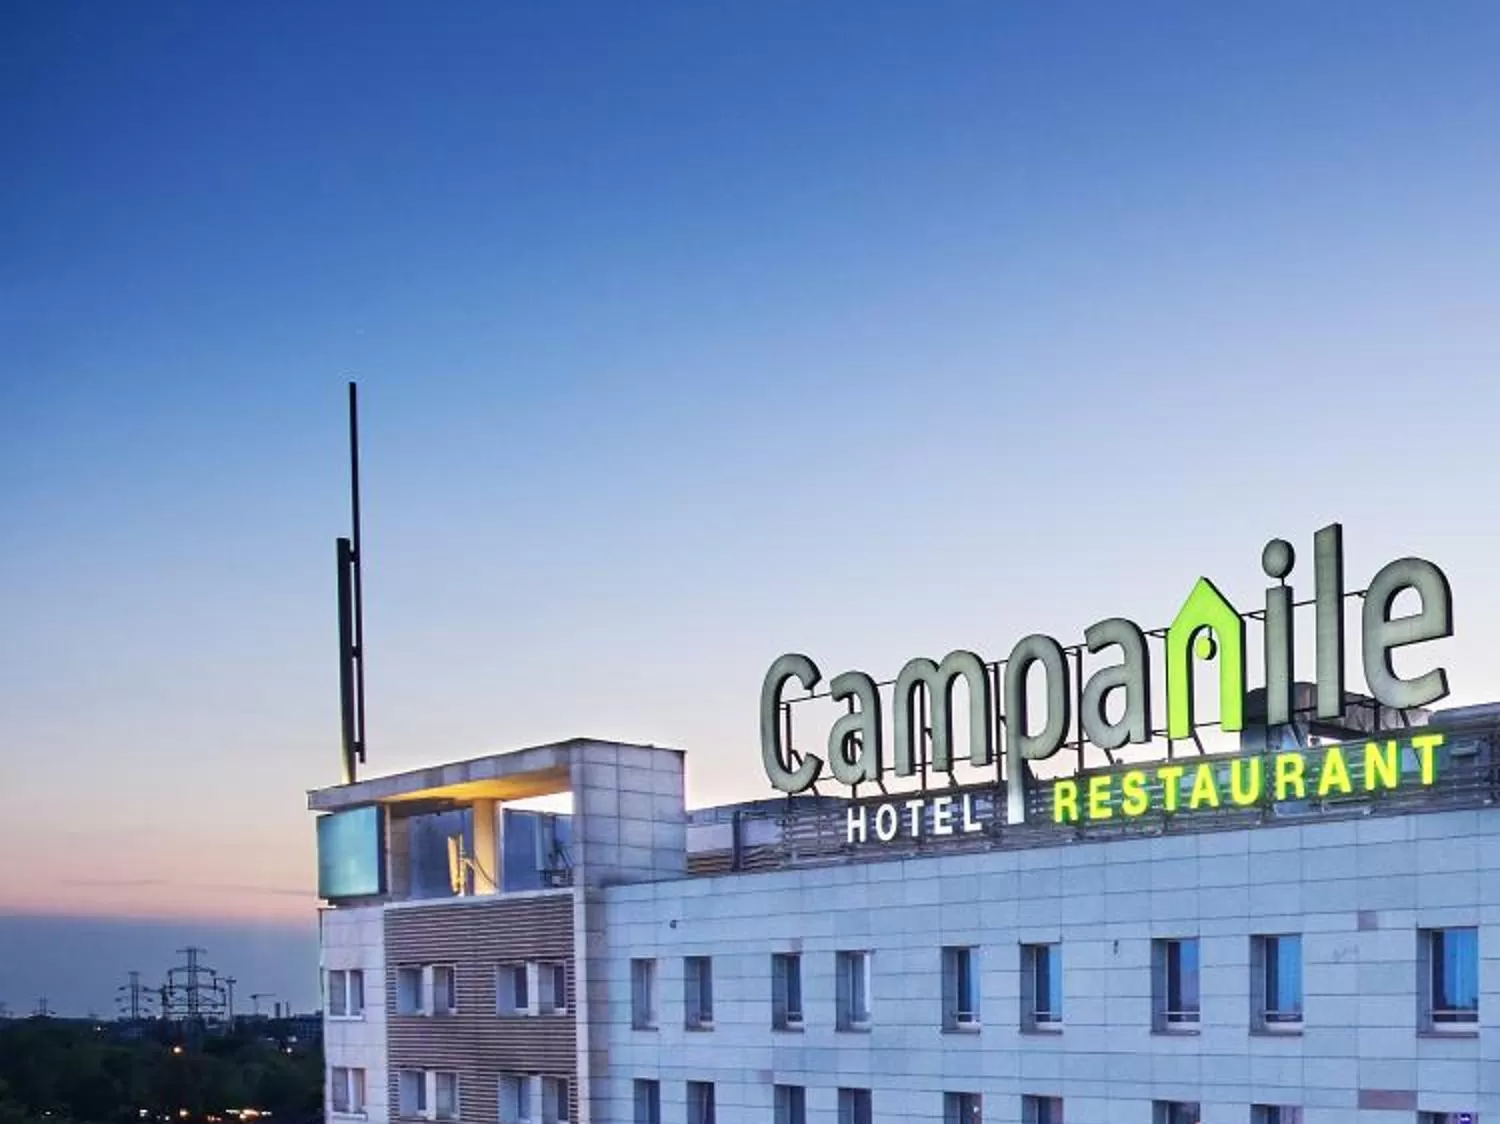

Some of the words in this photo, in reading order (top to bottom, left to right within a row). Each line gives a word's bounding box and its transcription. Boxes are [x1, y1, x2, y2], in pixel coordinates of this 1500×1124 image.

[760, 522, 1454, 824] Campanile
[847, 794, 982, 843] HOTEL
[1053, 734, 1445, 825] RESTAURANT
